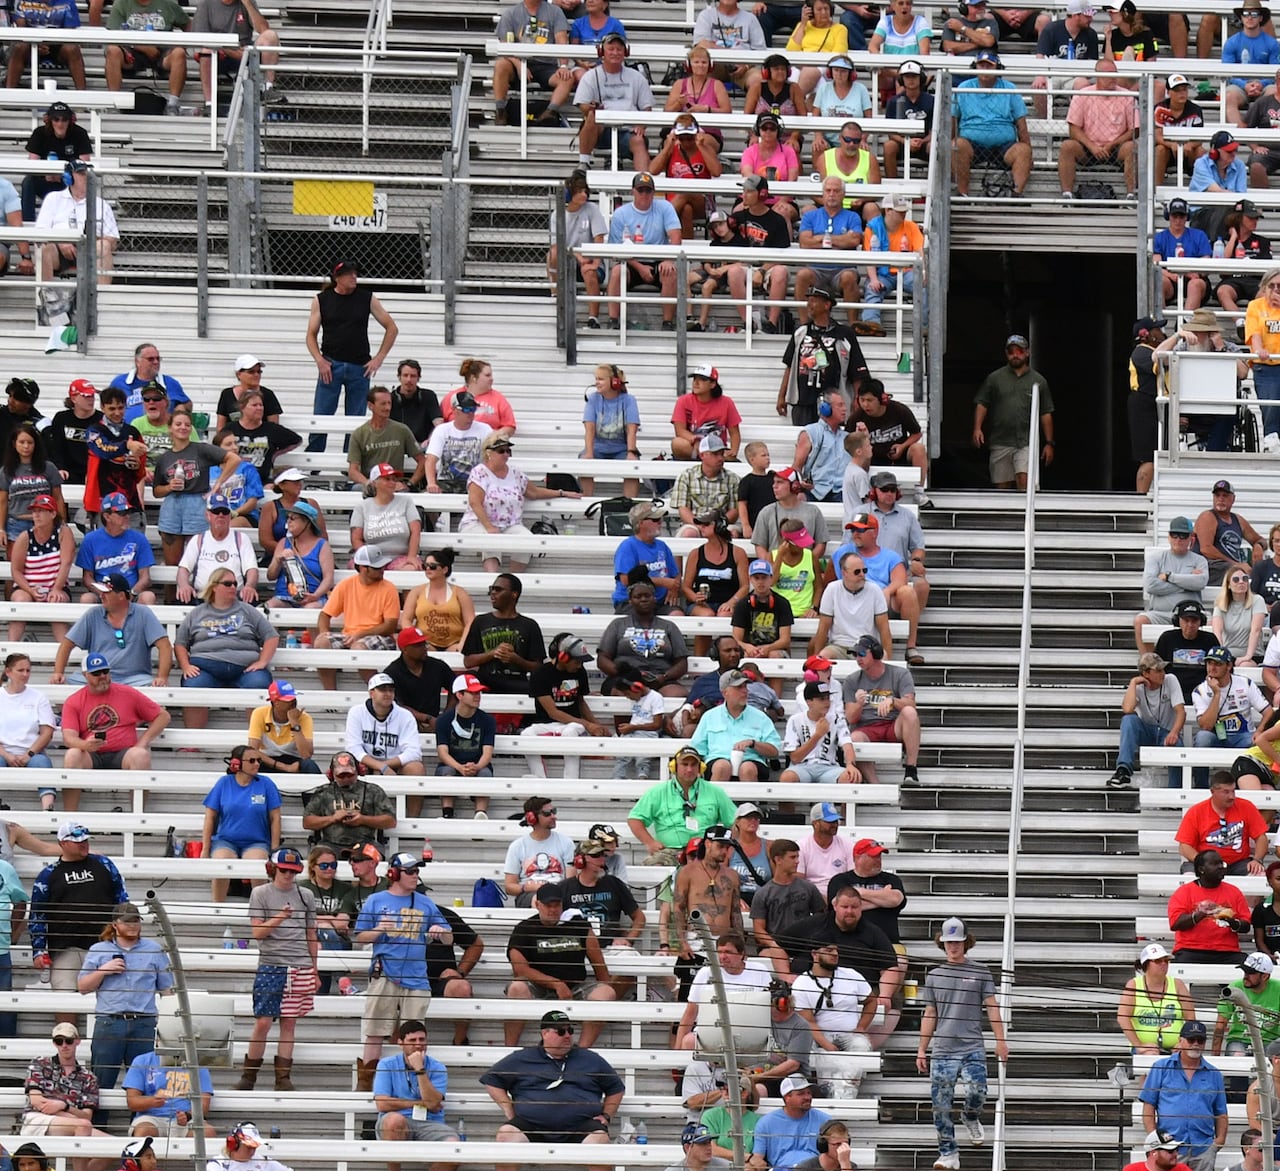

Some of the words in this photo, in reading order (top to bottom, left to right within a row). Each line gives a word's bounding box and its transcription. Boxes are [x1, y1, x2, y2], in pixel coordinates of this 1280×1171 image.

[143, 435, 172, 445] BUSC
[368, 509, 402, 522] Skittles
[367, 517, 403, 530] Skittles
[366, 525, 405, 540] Skittles
[95, 552, 136, 571] LARSON
[755, 612, 774, 626] 48
[333, 799, 361, 812] Huk
[65, 869, 94, 884] Huk
